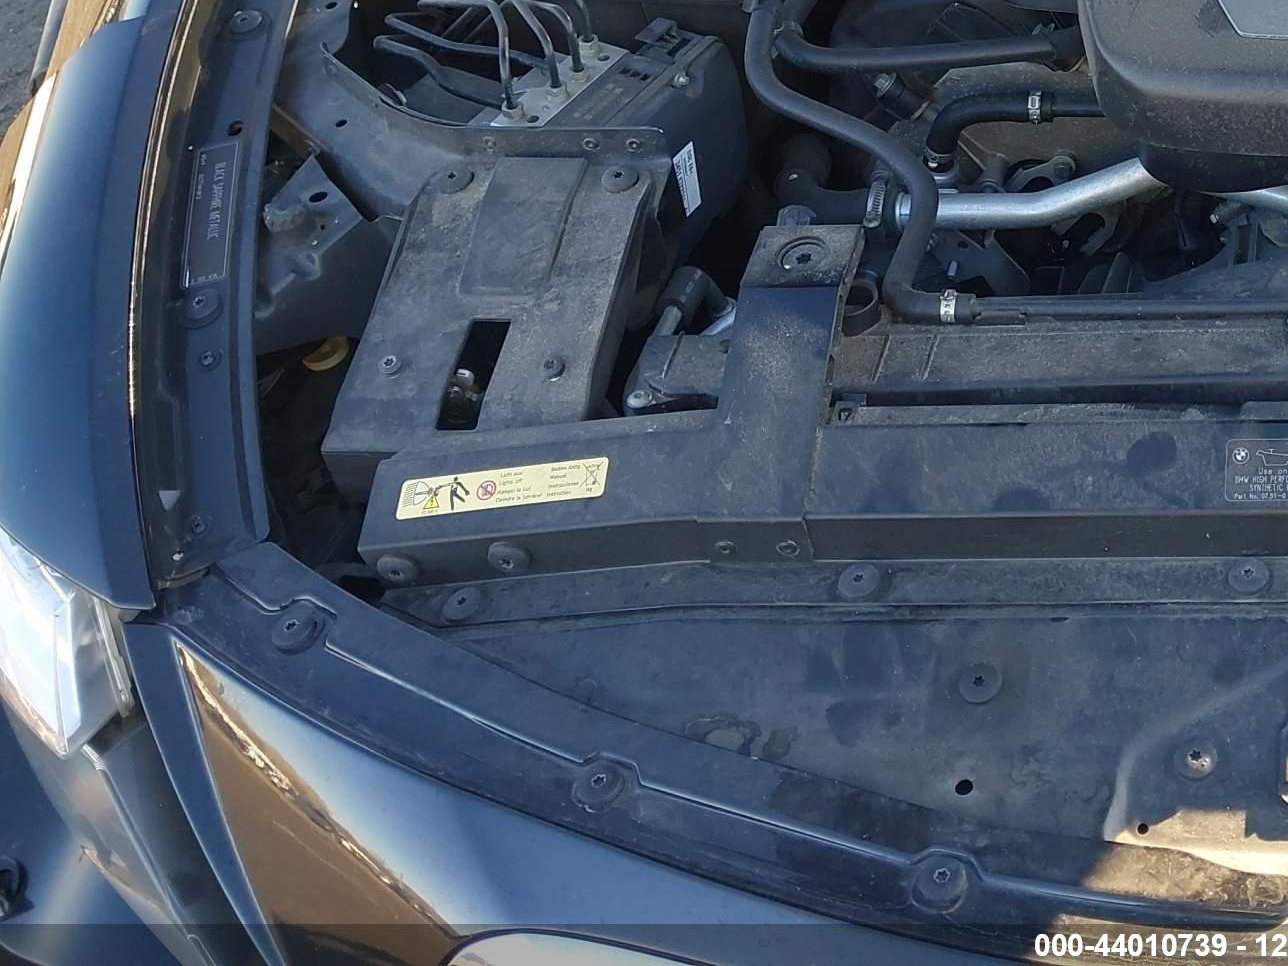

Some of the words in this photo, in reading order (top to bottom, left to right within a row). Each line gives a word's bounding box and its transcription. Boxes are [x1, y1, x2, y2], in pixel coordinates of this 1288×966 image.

[1258, 466, 1272, 474] Use
[1234, 476, 1250, 484] BMW
[1249, 484, 1283, 492] SYNTHETIC
